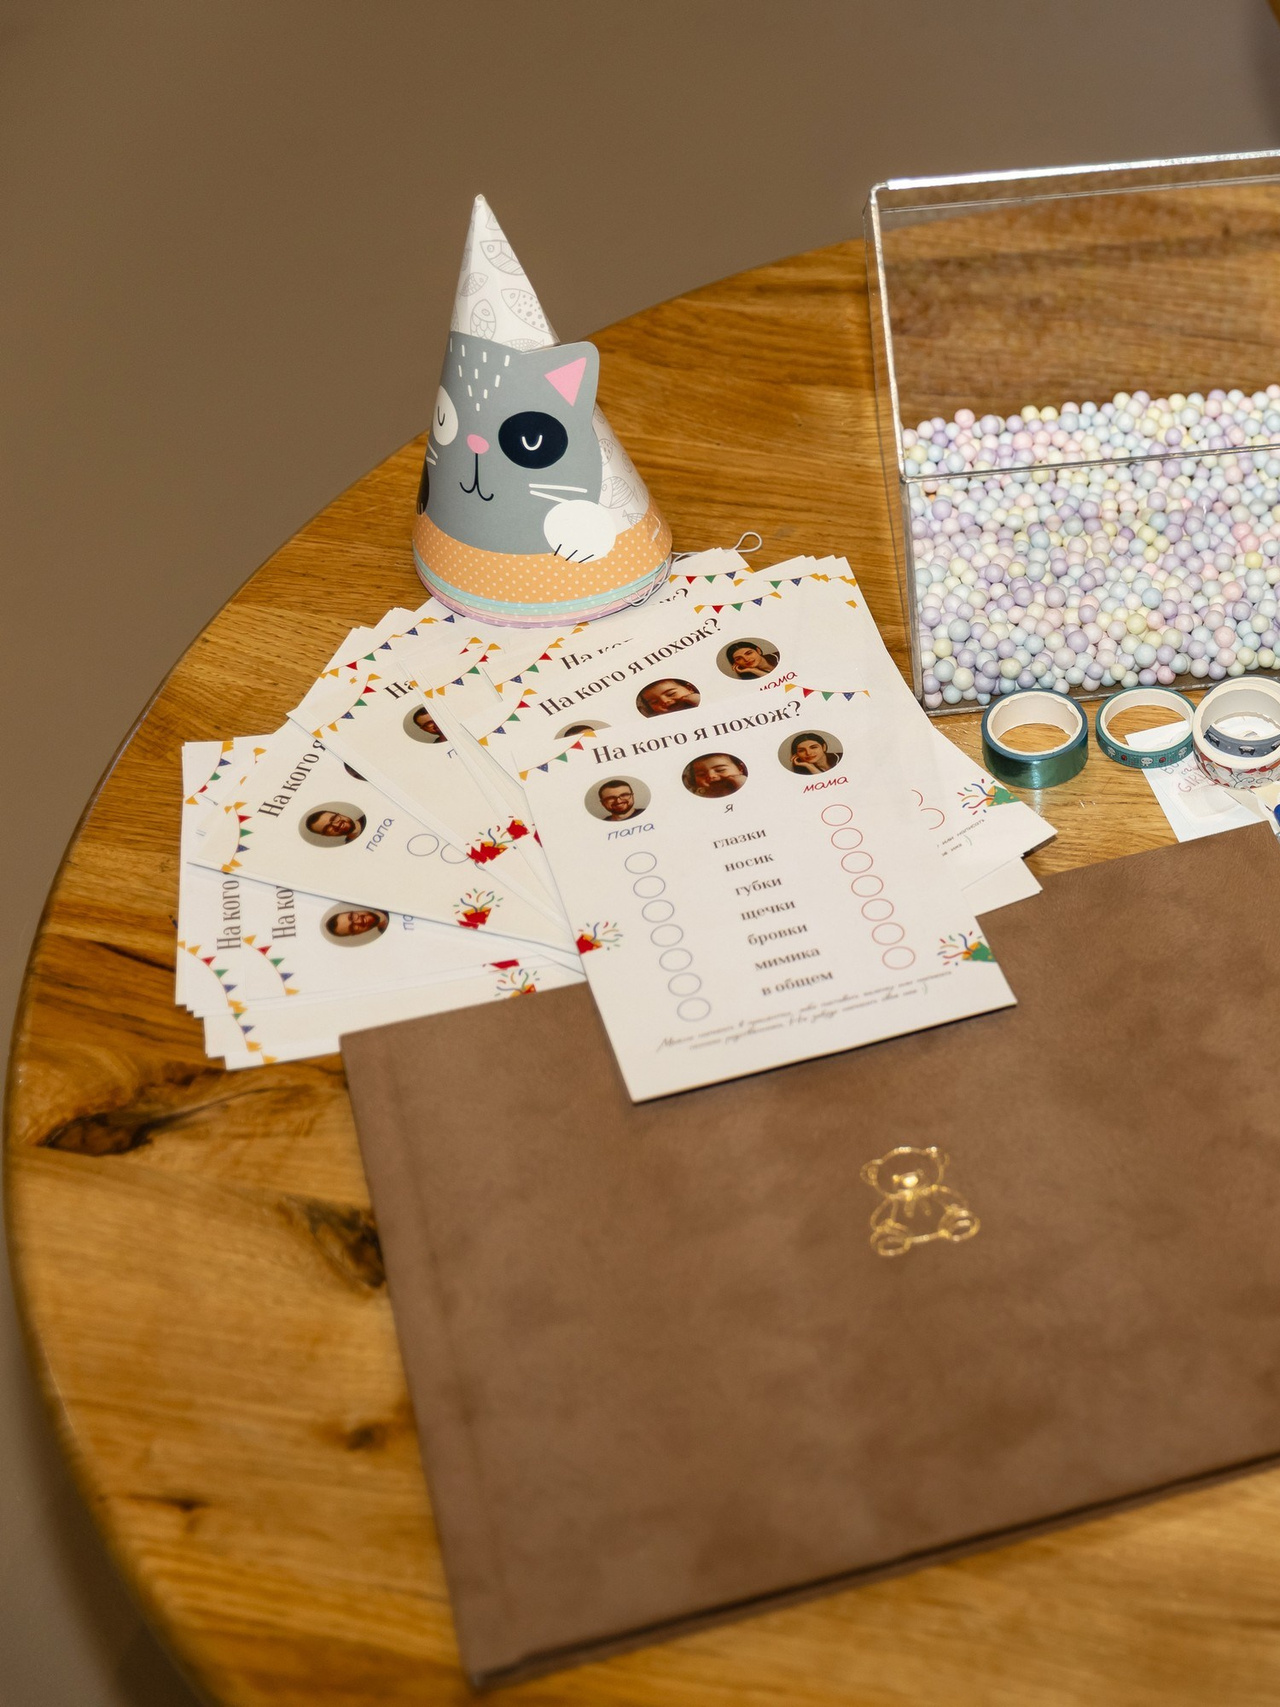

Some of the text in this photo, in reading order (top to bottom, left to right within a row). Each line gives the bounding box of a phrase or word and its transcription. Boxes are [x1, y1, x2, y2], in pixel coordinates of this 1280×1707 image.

[538, 692, 575, 717] На
[578, 670, 626, 695] кого
[628, 661, 645, 676] я
[643, 617, 722, 666] похож?
[759, 671, 798, 691] ама
[591, 700, 802, 764] На кого я похож?
[257, 790, 292, 818] На
[289, 753, 320, 792] кого
[803, 776, 849, 794] мама
[724, 804, 735, 814] я
[365, 817, 395, 852] папа
[607, 823, 655, 841] папа
[713, 829, 767, 849] глазки
[724, 853, 774, 872] носик
[735, 877, 782, 897] губки
[222, 879, 241, 922] кого
[740, 900, 796, 921] щечки
[217, 925, 242, 951] На
[272, 914, 296, 940] На
[747, 924, 808, 946] бровки
[754, 948, 821, 972] мимика
[761, 972, 834, 997] в общем
